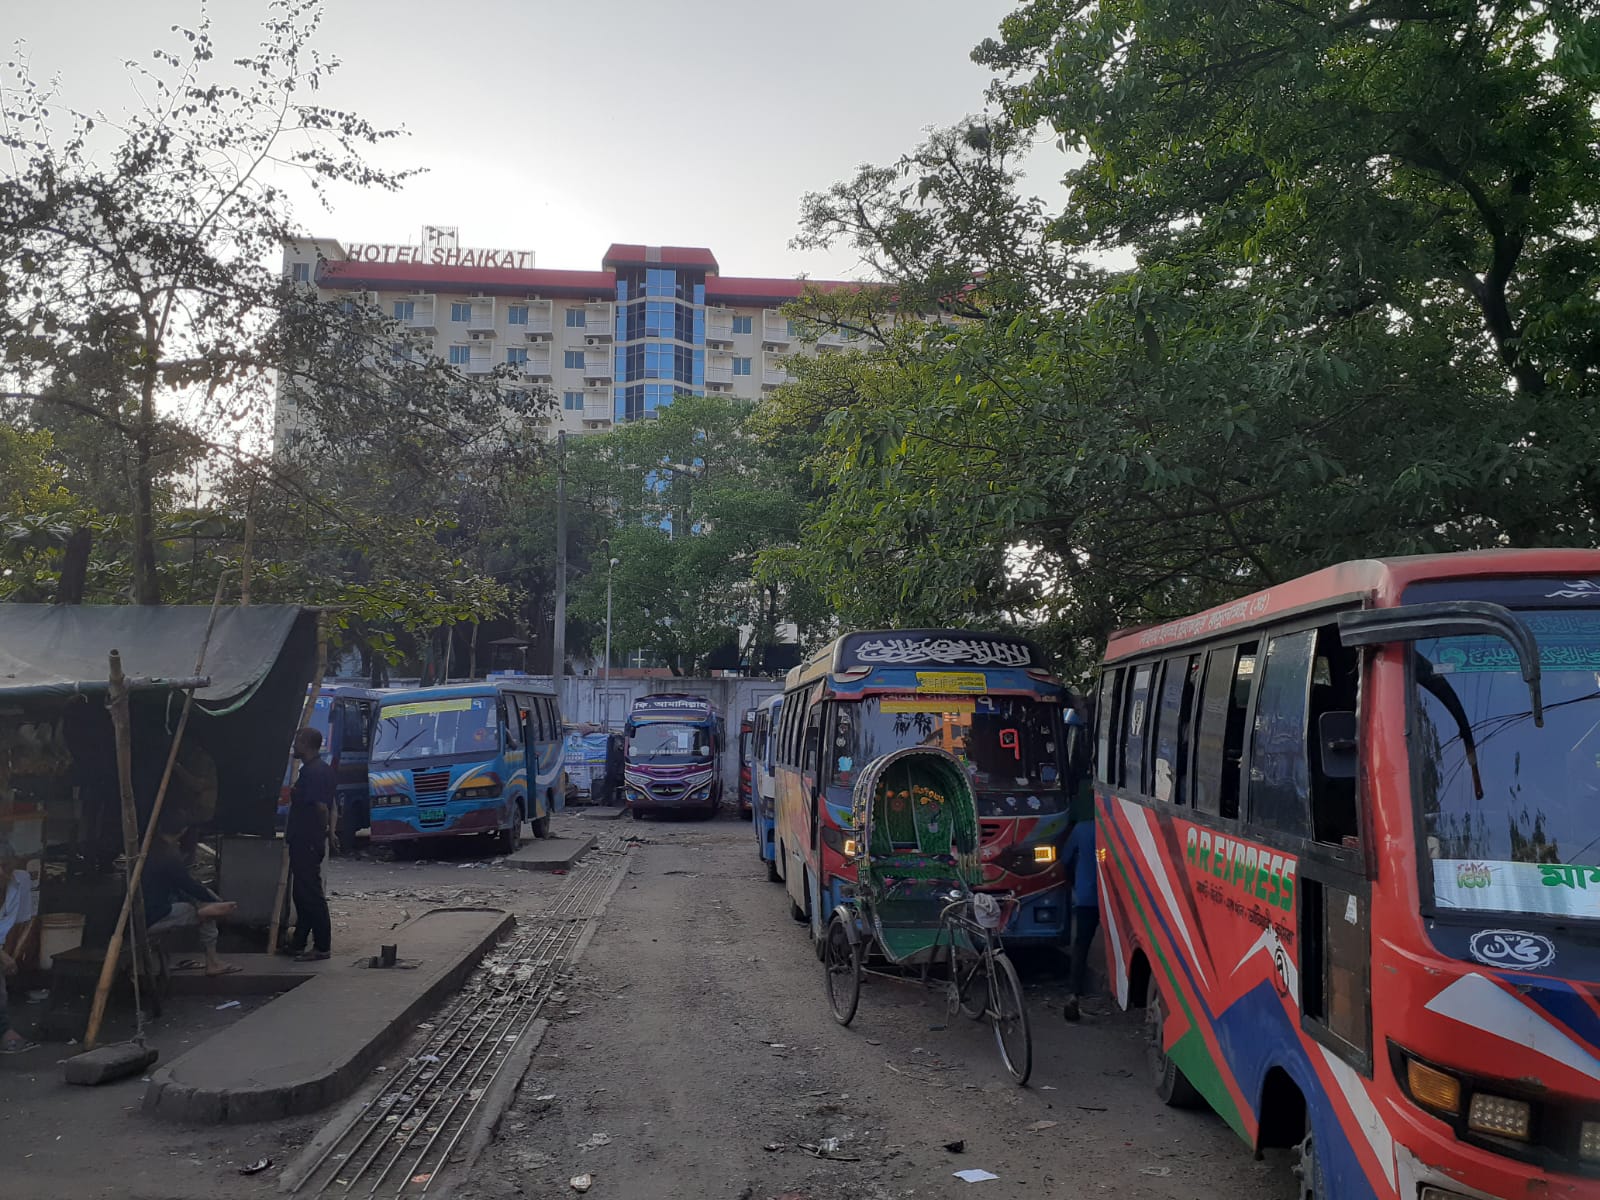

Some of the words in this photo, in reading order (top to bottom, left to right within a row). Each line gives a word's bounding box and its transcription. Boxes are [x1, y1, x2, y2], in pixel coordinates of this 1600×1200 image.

[348, 243, 422, 265] HOTEL
[430, 246, 530, 269] SHAIKAT
[1213, 835, 1297, 912] EXPRESS
